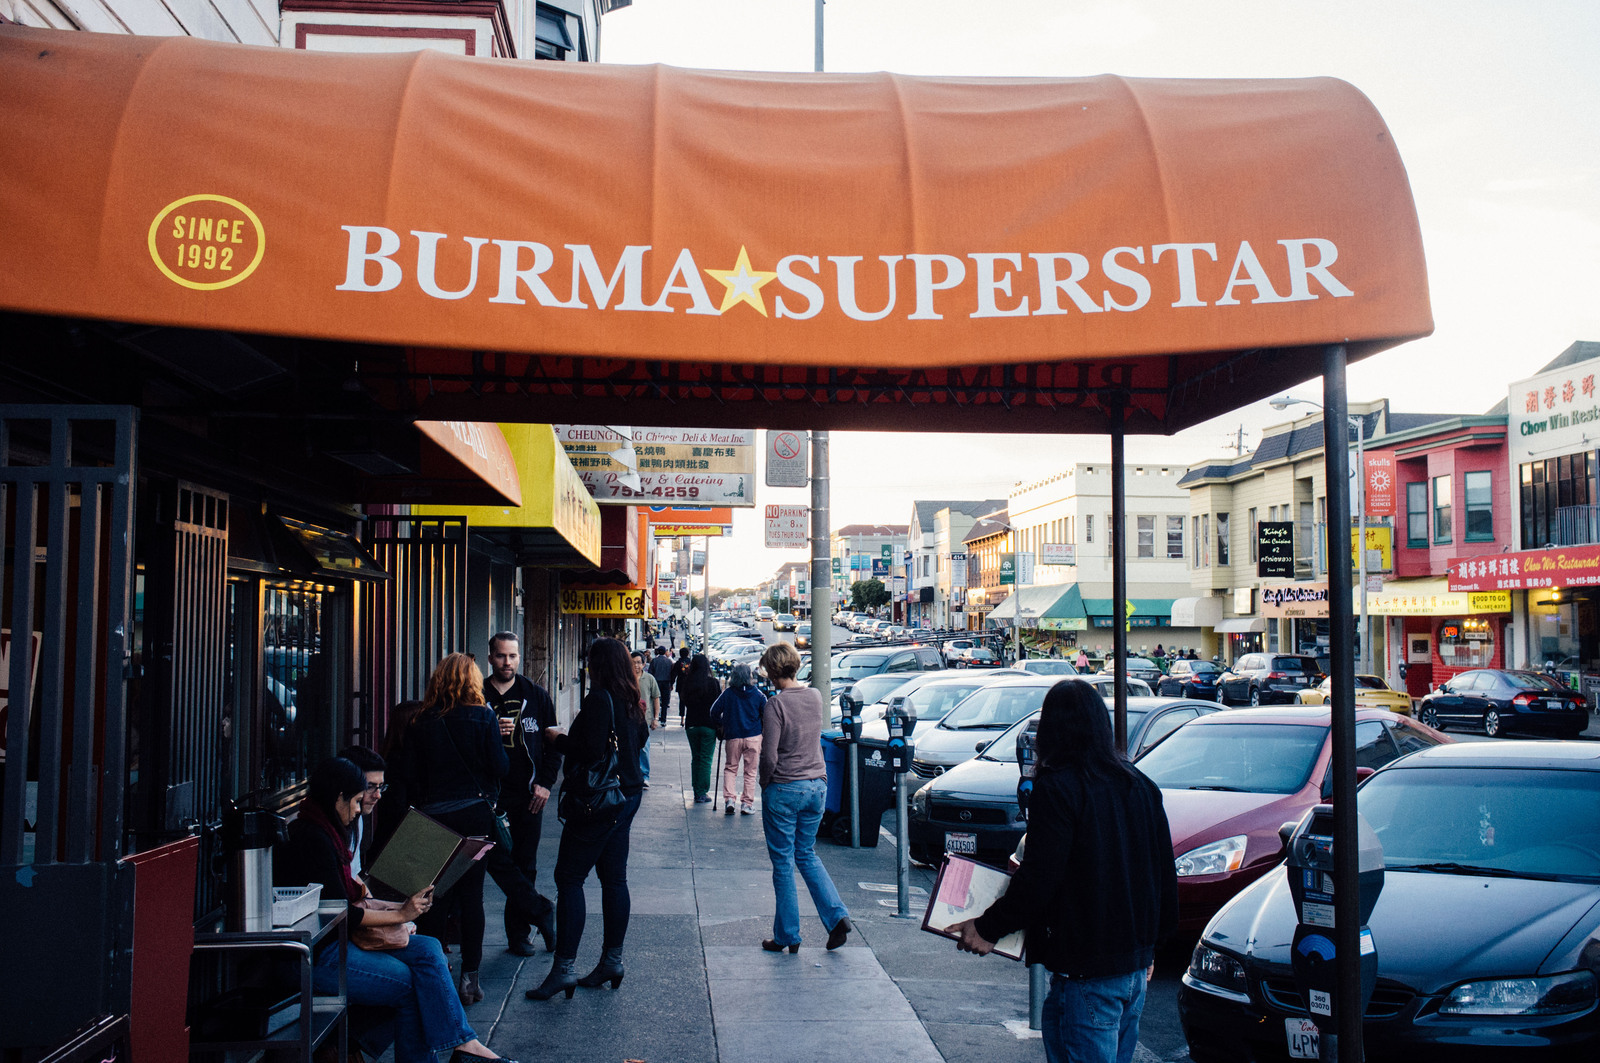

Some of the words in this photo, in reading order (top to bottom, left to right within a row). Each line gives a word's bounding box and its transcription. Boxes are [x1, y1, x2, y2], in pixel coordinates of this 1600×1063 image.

[173, 215, 245, 243] SINCE
[177, 244, 234, 270] 1992
[335, 225, 722, 316] BURMA
[775, 237, 1354, 321] SUPERSTAR
[1520, 420, 1547, 436] Chow
[1549, 413, 1569, 430] Win
[1571, 405, 1600, 426] Rest
[567, 430, 613, 440] CHEUNG
[682, 433, 699, 442] Deli
[700, 433, 708, 442] &
[710, 433, 729, 443] Meat
[730, 433, 745, 443] Inc.
[1369, 458, 1390, 466] skulls
[658, 474, 668, 484] &
[675, 474, 724, 486] Catering
[609, 486, 699, 497] 752-4259
[767, 506, 778, 517] NO
[780, 509, 806, 517] PARKING
[1263, 528, 1288, 537] King's
[1524, 557, 1541, 573] Chow
[1557, 555, 1600, 570] Restaurant
[584, 592, 612, 610] Milk
[1311, 1002, 1329, 1011] 03070
